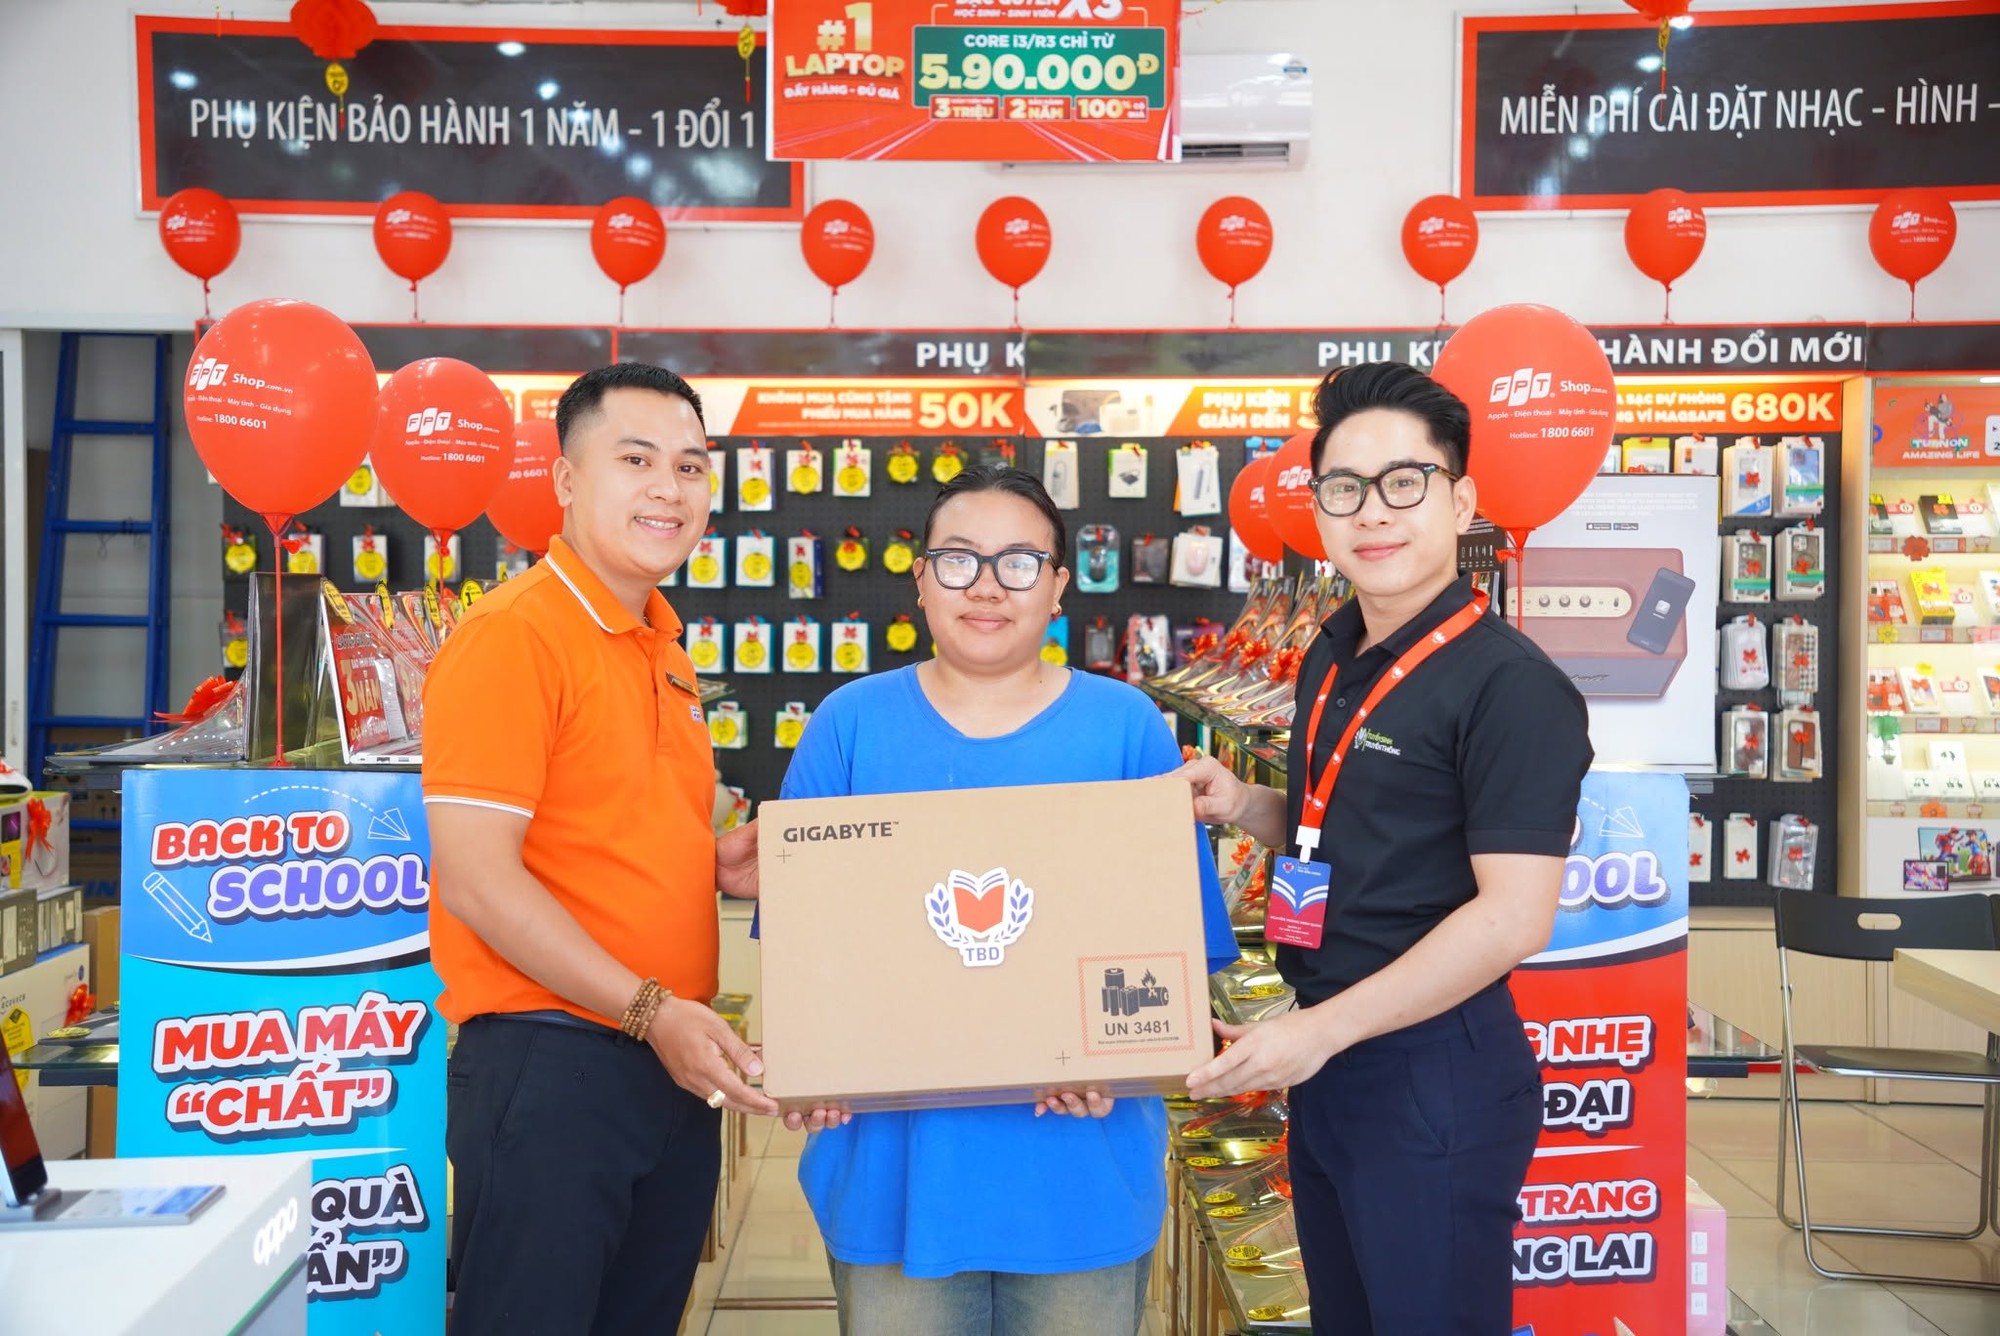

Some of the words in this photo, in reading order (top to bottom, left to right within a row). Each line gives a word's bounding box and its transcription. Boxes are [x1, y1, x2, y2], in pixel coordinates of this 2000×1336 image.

[817, 2, 872, 51] #1
[963, 33, 1010, 48] CORE
[1059, 30, 1088, 48] CHỈ
[1091, 32, 1115, 48] TỪ
[785, 53, 905, 78] LAPTOP
[812, 84, 848, 96] HÀNG
[191, 99, 256, 148] PHỤ
[267, 95, 337, 150] KIỆN
[348, 94, 411, 143] BẢO
[420, 98, 510, 145] HÀNH
[521, 109, 534, 145] 1
[547, 101, 619, 146] NĂM
[651, 110, 665, 147] 1
[675, 97, 729, 148] ĐỔI
[740, 111, 754, 148] 1
[935, 98, 950, 118] 3
[952, 104, 994, 120] TRIỆU
[1010, 99, 1026, 119] 2
[1028, 104, 1064, 119] NĂM
[1500, 84, 1579, 135] MIỄN
[1588, 86, 1643, 134] PHÍ
[1648, 86, 1698, 133] CÀI
[1706, 84, 1768, 139] ĐẶT
[1776, 87, 1864, 137] NHẠC
[1896, 78, 1978, 126] HÌNH
[916, 342, 988, 374] PHỤ
[1598, 333, 1702, 365] HÀNH
[1711, 328, 1779, 364] ĐỔI
[1790, 331, 1863, 364] MỚI
[189, 357, 229, 391] FPT
[1488, 367, 1552, 407] FPT
[227, 397, 240, 406] Máy
[241, 400, 255, 408] tính
[259, 403, 272, 411] Gia
[273, 406, 292, 416] dụng
[806, 391, 835, 405] MUA
[918, 392, 1015, 429] 50K
[1203, 391, 1244, 411] PHỤ
[1246, 388, 1291, 412] KIỆN
[1625, 393, 1654, 408] SẠC
[1678, 390, 1726, 406] PHÒNG
[1730, 392, 1835, 424] 680K
[214, 413, 237, 425] 1800
[239, 417, 267, 430] 6601
[405, 407, 452, 437] FPT
[843, 408, 872, 420] MUA
[1198, 408, 1247, 429] GIẢM
[1249, 407, 1291, 429] ĐẾN
[1487, 412, 1509, 421] Apple
[1514, 410, 1532, 419] Điện
[1532, 409, 1552, 417] thoại
[1558, 409, 1573, 417] Máy
[1637, 408, 1653, 423] VÍ
[1655, 410, 1727, 424] MAGSAFE
[1509, 431, 1538, 439] Hotline:
[1540, 427, 1569, 439] 1800
[1571, 426, 1595, 438] 6601
[443, 453, 464, 462] 1800
[466, 455, 485, 463] 6601
[1902, 450, 1954, 459] AMAZING
[523, 468, 548, 479] 6601
[155, 818, 282, 862] BACK
[290, 813, 347, 850] TO
[212, 859, 427, 913] SCHOOL
[1560, 856, 1661, 898] OOL
[965, 946, 1000, 962] TBD
[162, 1017, 289, 1066] MUA
[303, 999, 420, 1054] MÁY
[1104, 1022, 1129, 1036] UN
[1134, 1020, 1170, 1035] 3481
[1553, 1022, 1645, 1060] NHẸ
[1544, 1085, 1624, 1125] ĐẠI
[311, 1172, 418, 1222] QUÀ
[1520, 1184, 1652, 1218] TRANG
[306, 1231, 398, 1286] ẨN”
[1512, 1242, 1563, 1275] NG
[1573, 1238, 1647, 1272] LAI
